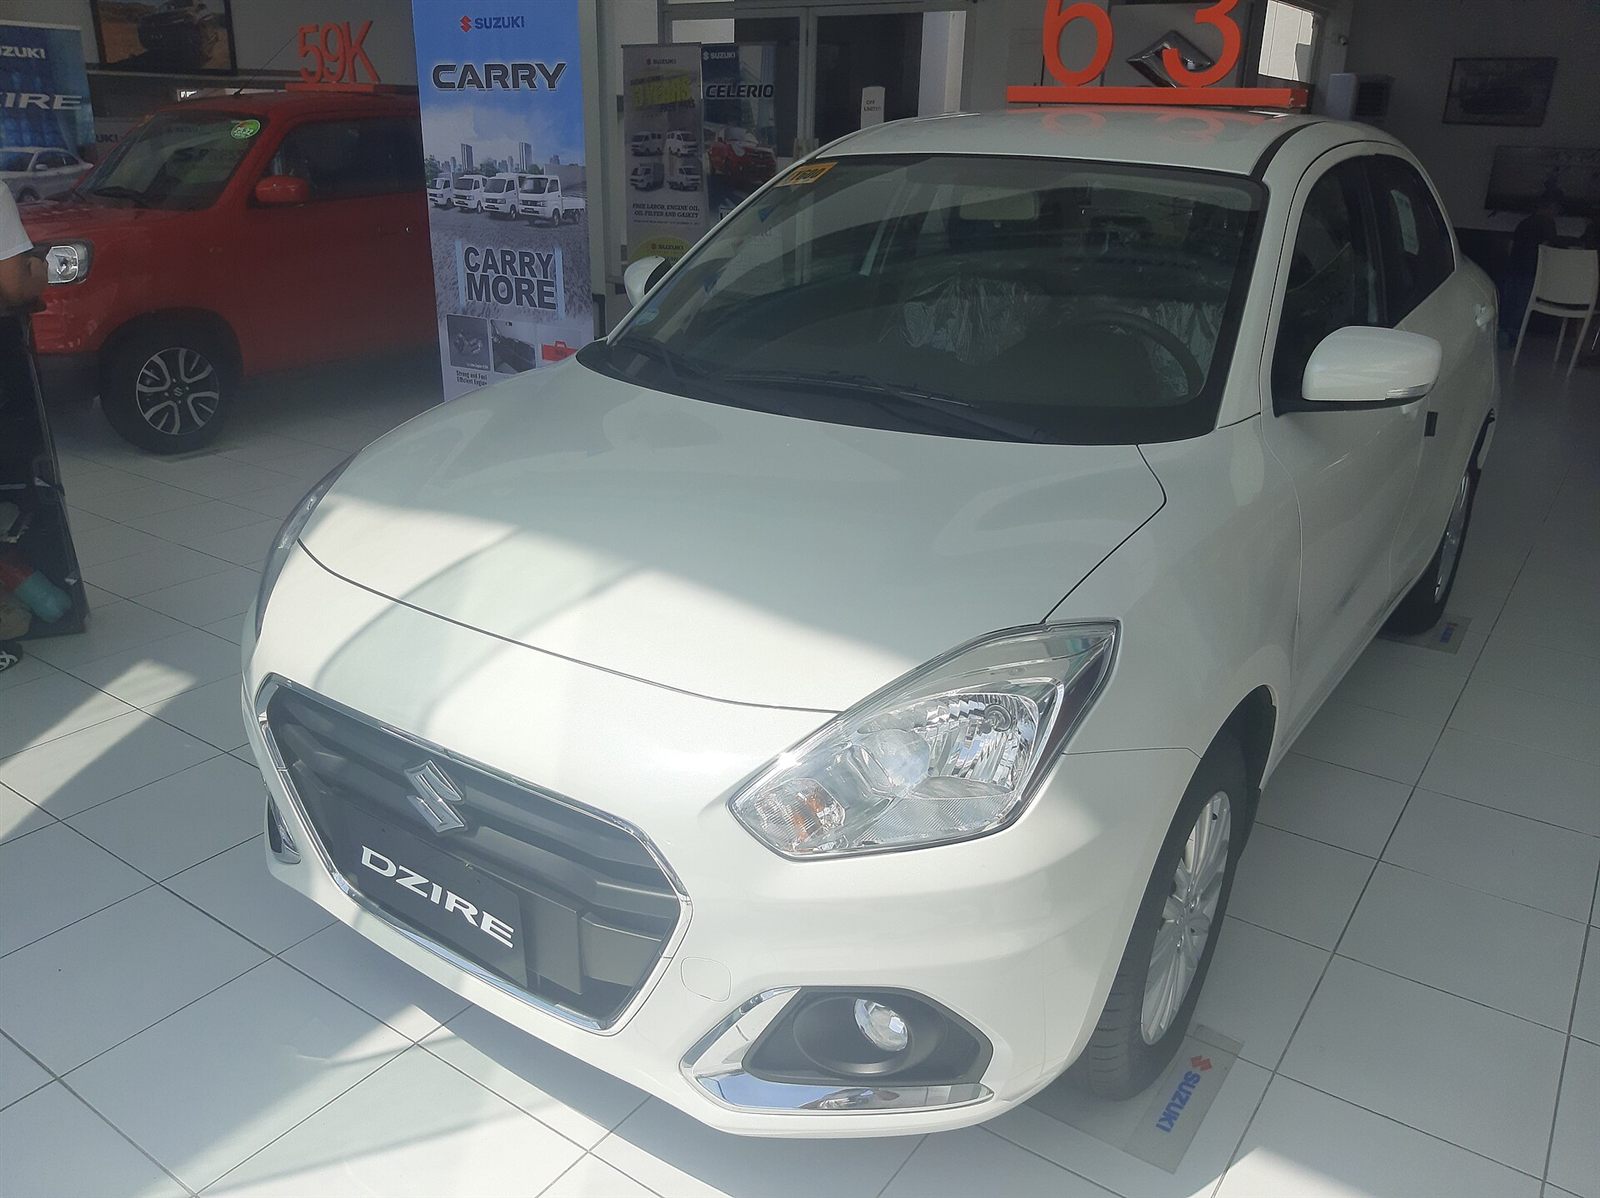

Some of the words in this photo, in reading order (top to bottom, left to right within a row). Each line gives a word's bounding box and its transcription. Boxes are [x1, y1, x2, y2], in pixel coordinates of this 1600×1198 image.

[474, 16, 525, 29] SUZUKI
[298, 21, 380, 83] 59K
[709, 52, 735, 60] SUZUKI
[432, 62, 567, 90] CARRY
[706, 84, 774, 99] CELERIO
[464, 246, 553, 279] CARRY
[466, 272, 557, 310] MORE
[361, 844, 515, 949] DZIRE
[1156, 1070, 1201, 1133] SUZUKI
